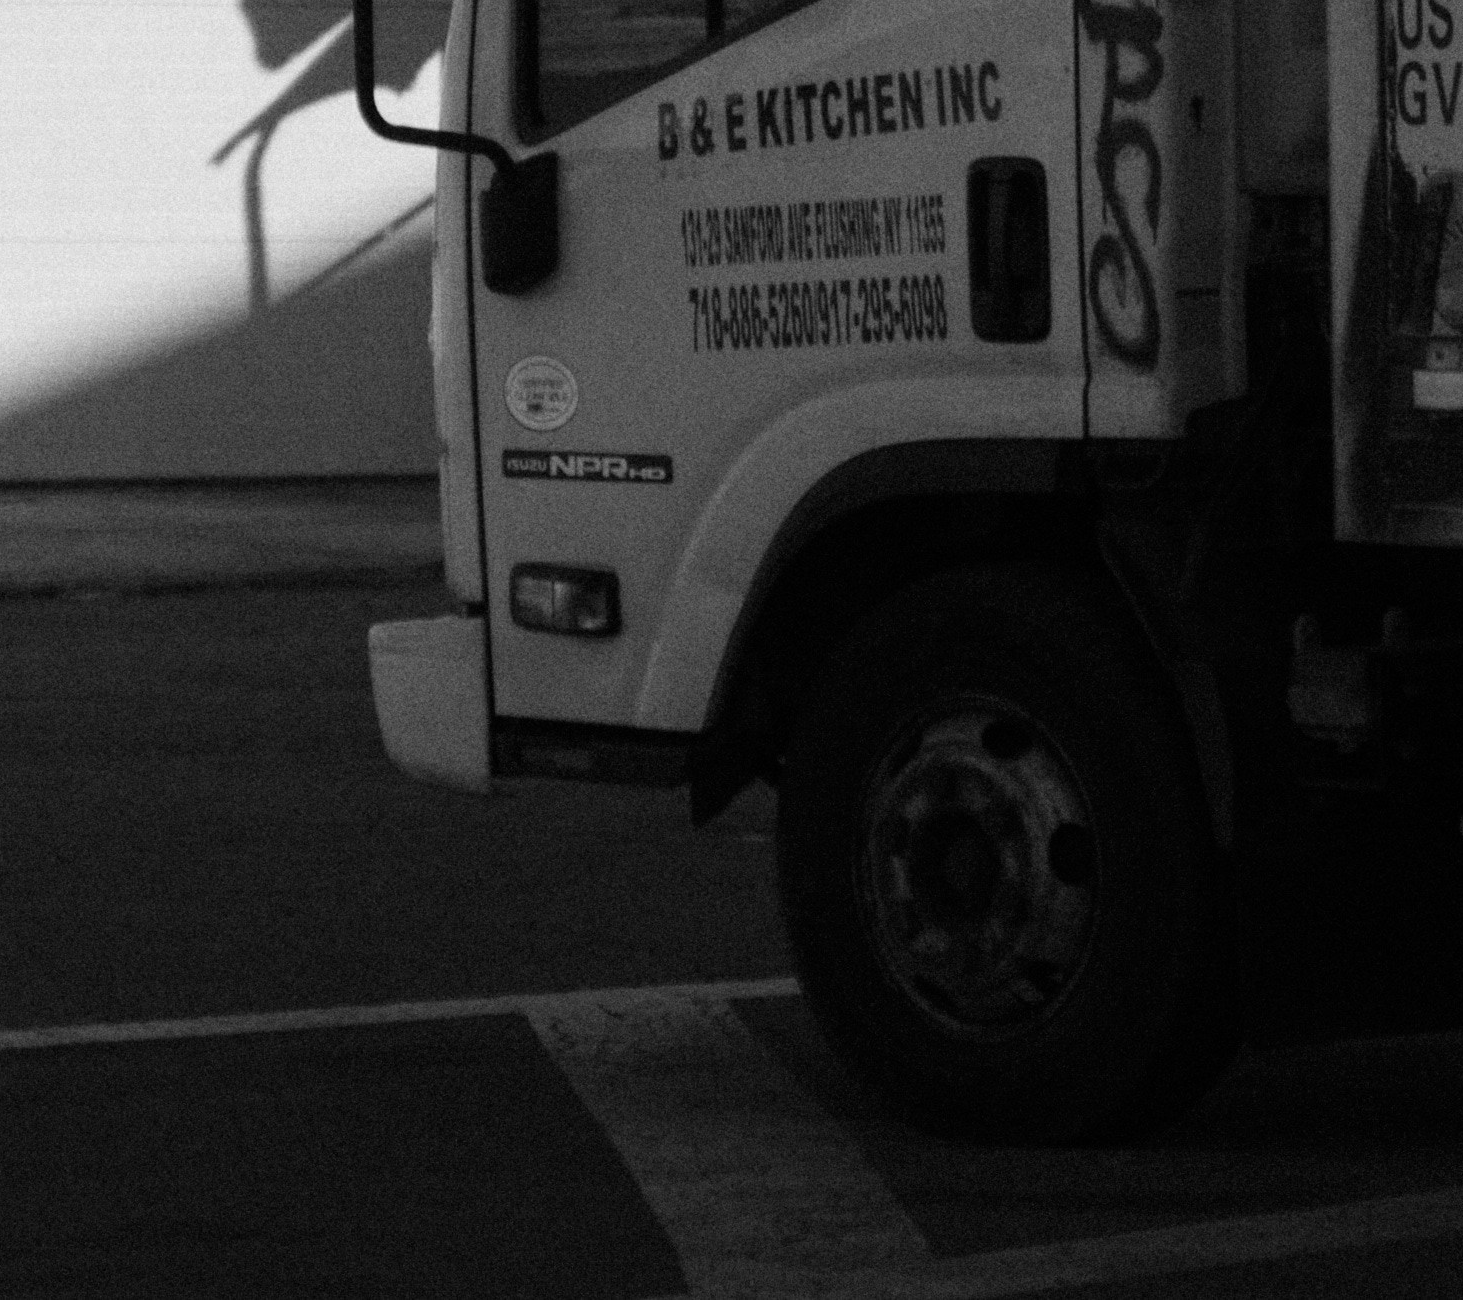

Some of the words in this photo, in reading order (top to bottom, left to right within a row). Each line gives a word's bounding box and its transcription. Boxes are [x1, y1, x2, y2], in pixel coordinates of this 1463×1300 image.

[658, 102, 679, 161] B
[690, 96, 715, 157] &
[725, 93, 748, 153] E
[756, 69, 926, 150] KITCHEN
[934, 60, 1003, 127] INC
[724, 203, 785, 266] SANFORD
[787, 202, 813, 261] AVE
[814, 198, 882, 260] FLUSHING
[505, 458, 547, 473] ISUZU
[549, 455, 629, 479] NPR
[629, 467, 666, 480] HD
